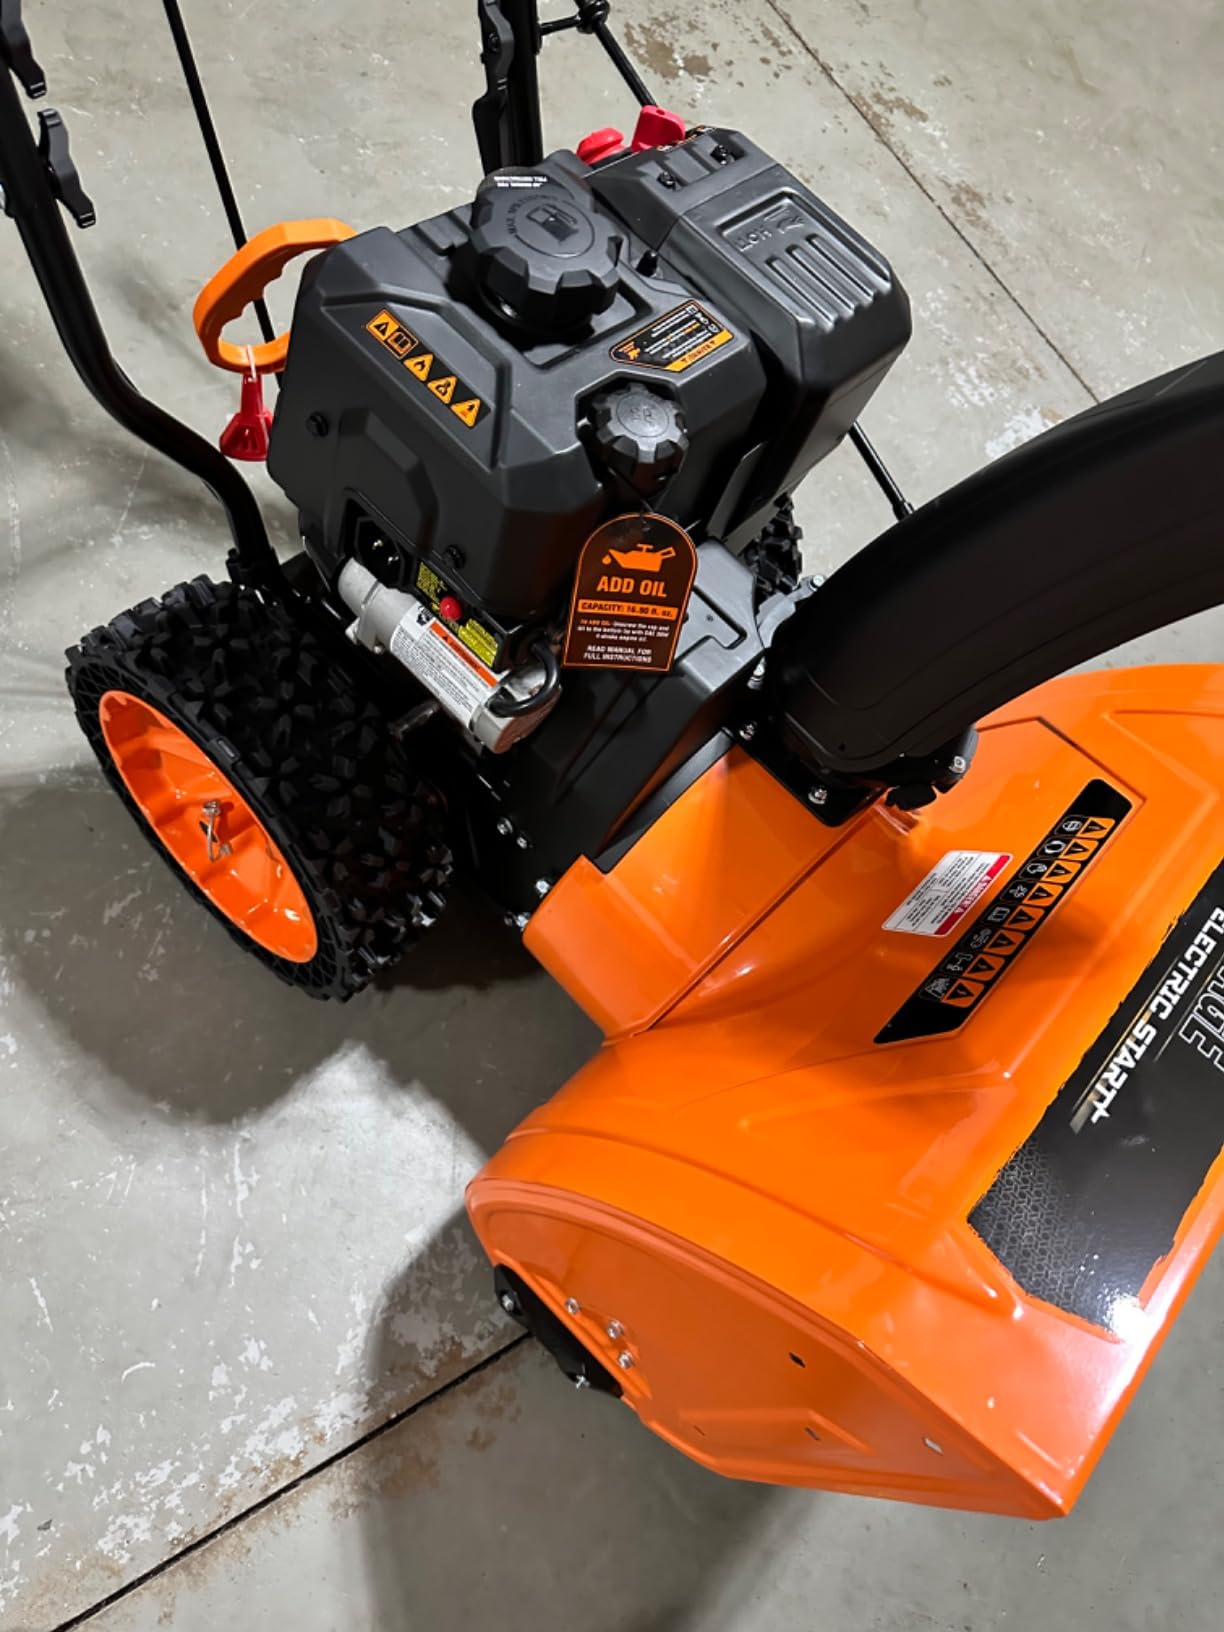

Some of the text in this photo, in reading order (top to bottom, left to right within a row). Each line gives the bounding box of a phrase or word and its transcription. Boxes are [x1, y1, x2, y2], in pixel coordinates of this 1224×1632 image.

[596, 575, 667, 598] ADD OIL
[583, 652, 601, 660] FULL
[1091, 907, 1224, 1115] ELECTRIC START
